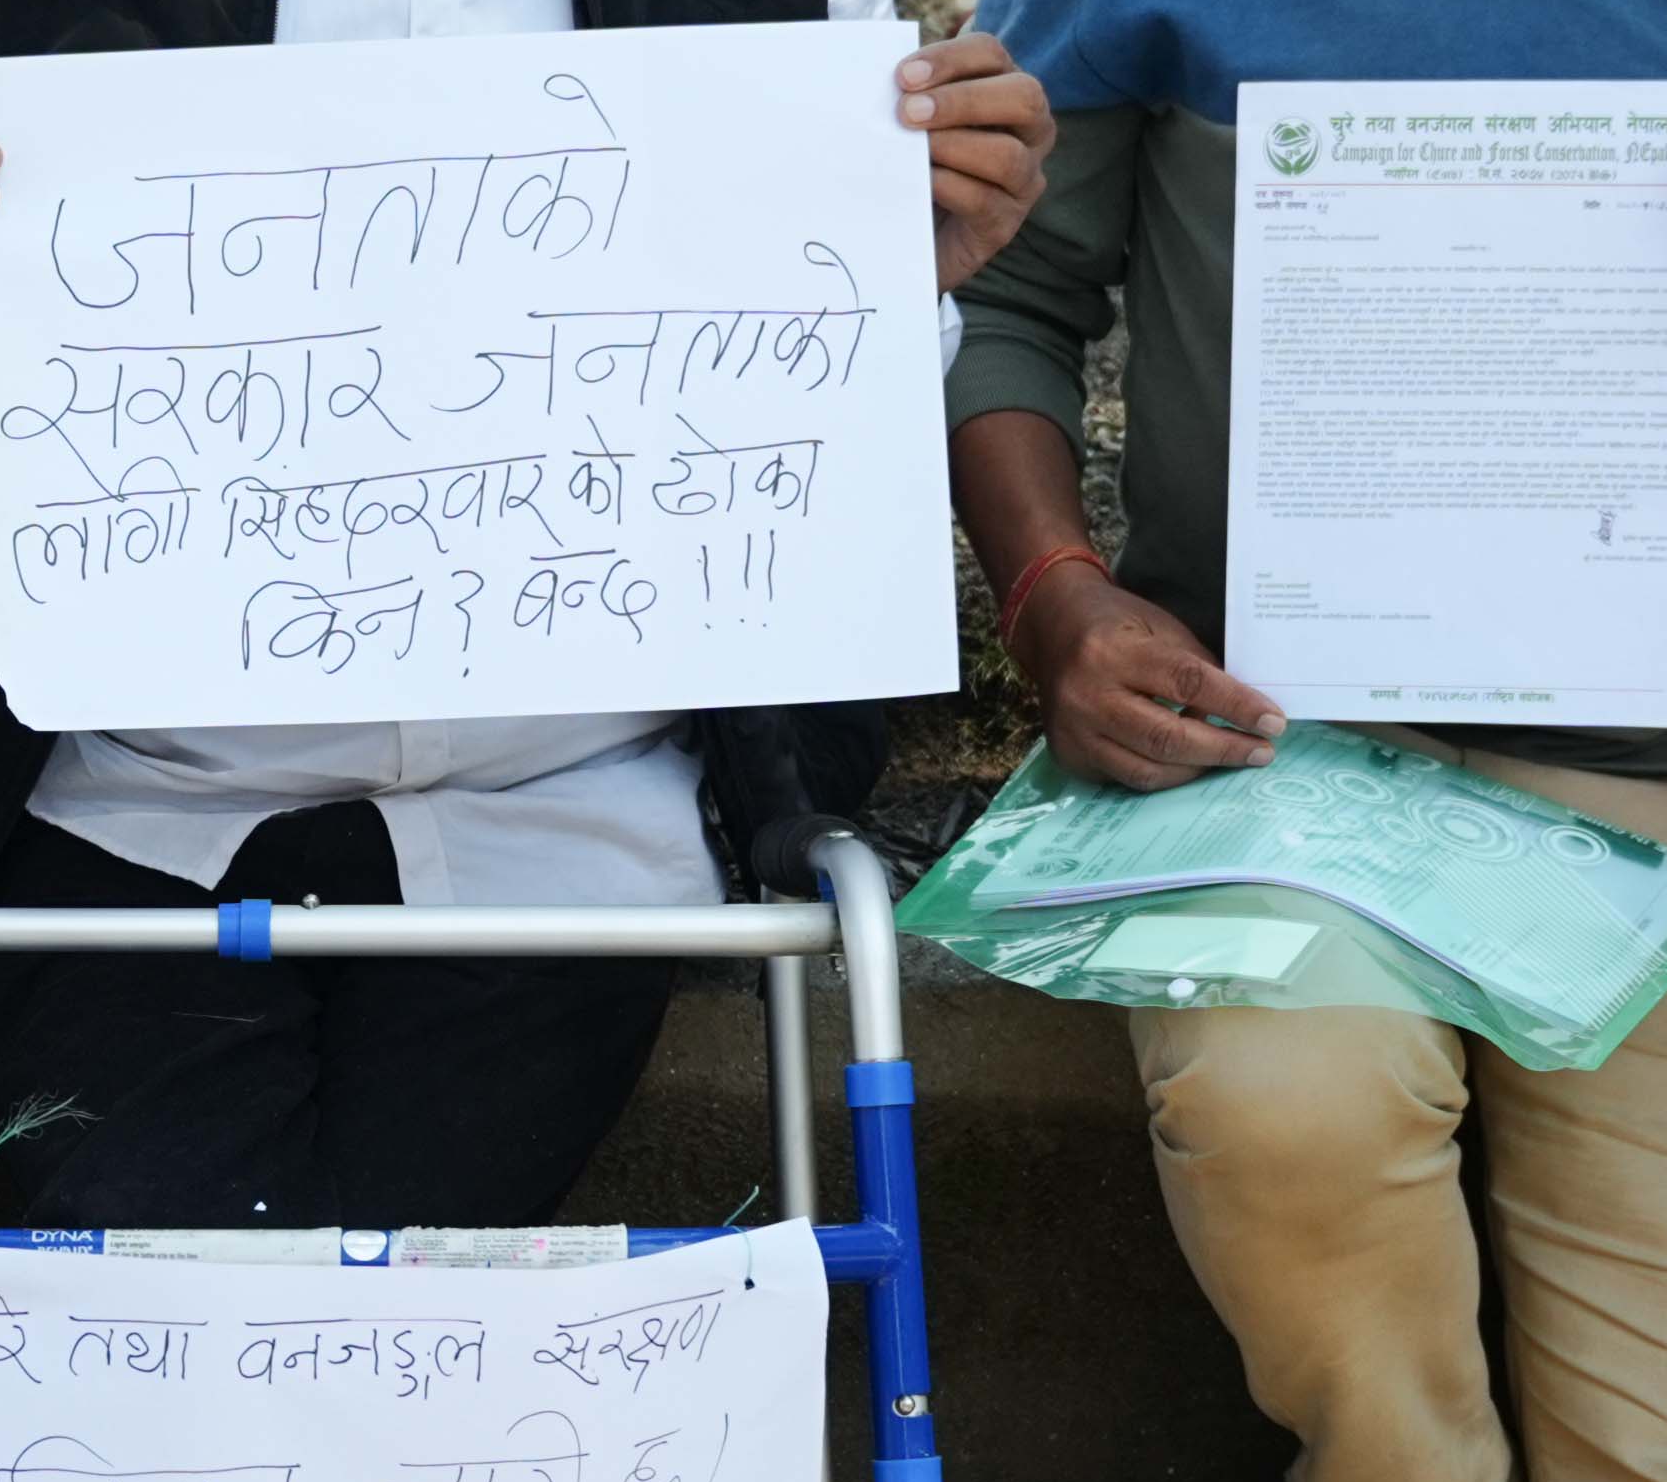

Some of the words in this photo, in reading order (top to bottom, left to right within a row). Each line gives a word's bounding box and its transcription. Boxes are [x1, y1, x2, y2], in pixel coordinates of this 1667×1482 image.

[1331, 143, 1394, 164] Campaign
[1397, 143, 1415, 162] for
[1460, 143, 1482, 161] and
[1486, 142, 1529, 164] Forest
[52, 74, 629, 313] जनताको
[0, 326, 411, 499] सरकार
[431, 241, 876, 415] जनताको
[31, 1230, 93, 1242] DYNA
[67, 1315, 208, 1382] तथा
